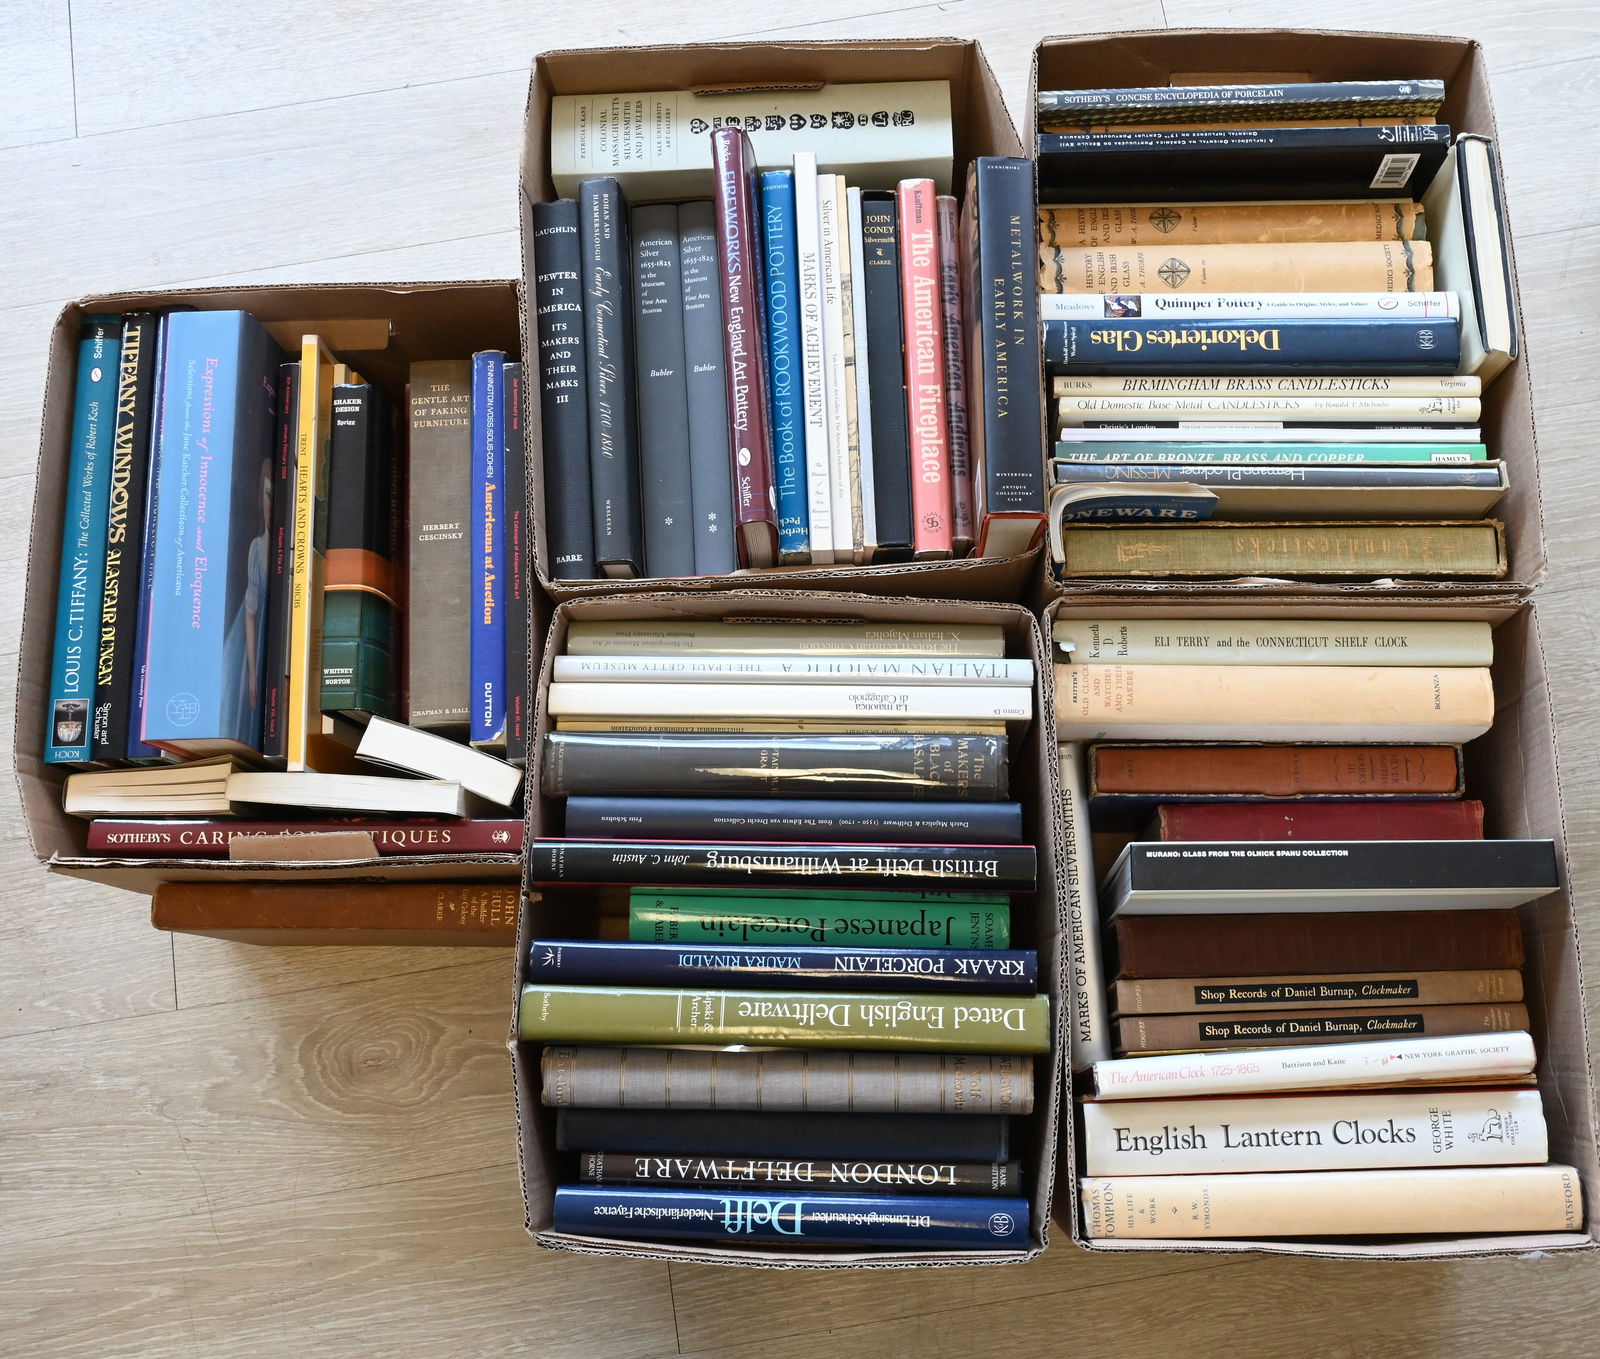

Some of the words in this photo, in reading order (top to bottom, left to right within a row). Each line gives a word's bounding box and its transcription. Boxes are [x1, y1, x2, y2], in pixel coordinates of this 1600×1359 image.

[1064, 95, 1110, 104] SOTHEBY'S
[1155, 92, 1219, 101] ENCYCLOPEDIA
[1235, 90, 1284, 98] PORCELAIN
[536, 226, 576, 237] LAUGHLIN
[726, 171, 741, 273] FIREWORKS
[683, 234, 714, 243] American
[683, 245, 701, 253] Silver
[769, 205, 784, 276] POTTERY
[912, 229, 933, 267] The
[641, 260, 671, 268] 1655-1825
[824, 239, 833, 281] American
[1010, 216, 1023, 319] METALWORK
[538, 272, 577, 282] PEWTER
[803, 253, 817, 299] MARKS
[729, 276, 743, 302] New
[538, 304, 581, 314] AMERICA
[994, 279, 1005, 330] EARLY
[1155, 298, 1213, 310] Quimper
[1218, 297, 1263, 310] Pottery
[728, 307, 747, 356] England
[913, 276, 938, 374] American
[94, 328, 104, 358] Schiffer
[542, 338, 579, 347] MAKERS
[770, 281, 791, 396] ROOKWOOD
[1091, 330, 1143, 351] Glas
[1147, 330, 1280, 350] Dekoriertes
[118, 326, 141, 416] TIFFANY
[546, 366, 576, 375] THEIR
[650, 369, 673, 377] Buhler
[693, 364, 716, 372] Buhler
[734, 359, 747, 384] Art
[806, 325, 823, 428] ACHIEVEMENT
[996, 340, 1008, 418] AMERICA
[200, 358, 218, 433] Expressions
[431, 384, 450, 392] THE
[546, 380, 578, 389] MARKS
[1122, 379, 1220, 390] BIRMINGHAM
[1226, 378, 1272, 390] BRASS
[1278, 379, 1390, 390] CANDLESTICKS
[412, 396, 447, 405] GENTLE
[451, 395, 469, 403] ART
[414, 408, 427, 416] OF
[735, 386, 748, 431] Pottery
[1077, 400, 1096, 410] Old
[1101, 400, 1145, 409] Domestic
[1208, 400, 1300, 409] CANDLESTICKS
[88, 401, 98, 428] Koch
[414, 418, 469, 427] FURNITURE
[86, 429, 95, 450] Robert
[779, 420, 794, 464] Book
[916, 384, 944, 484] Fireplace
[82, 460, 95, 485] Works
[108, 422, 134, 544] WINDOWS
[299, 466, 308, 503] HEARTS
[1105, 466, 1170, 478] MESSING
[198, 457, 212, 523] Innocence
[80, 490, 91, 529] Collected
[485, 482, 496, 557] Americana
[295, 530, 304, 574] CROWNS
[556, 554, 582, 563] BARRE
[102, 550, 120, 623] ALASTAIR
[190, 556, 207, 628] Eloquence
[484, 572, 495, 624] Auction
[1089, 624, 1099, 658] Kenneth
[1118, 626, 1127, 656] Roberts
[1155, 637, 1170, 646] ELI
[1177, 637, 1209, 647] TERRY
[1217, 638, 1232, 647] and
[1237, 638, 1249, 647] the
[1256, 636, 1328, 648] CONNECTICUT
[1335, 637, 1368, 647] SHELF
[1375, 637, 1408, 647] CLOCK
[98, 626, 116, 686] DUNCAN
[581, 662, 636, 670] MUSEUM
[64, 647, 81, 693] LOUIS
[912, 664, 1008, 678] ITALIAN
[484, 683, 492, 727] DUTTON
[849, 693, 896, 703] Cafaggiolo
[94, 707, 103, 739] Schuster
[107, 833, 170, 844] SOTHEBY'S
[1062, 789, 1078, 886] SILVERSMITHS
[613, 853, 647, 864] Austin
[664, 854, 689, 864] John
[707, 850, 842, 874] Williamsburg
[876, 859, 924, 876] Delft
[932, 860, 998, 877] British
[701, 914, 827, 942] Porcelain
[835, 910, 956, 945] Japanese
[1070, 891, 1085, 963] AMERICAN
[679, 955, 740, 967] RINALDI
[744, 956, 800, 968] MAURA
[834, 957, 944, 973] PORCELAIN
[956, 959, 1025, 975] KRAAK
[1201, 990, 1225, 1001] Shop
[1229, 989, 1267, 999] Records
[1272, 988, 1281, 997] of
[1285, 987, 1316, 997] Daniel
[1320, 987, 1357, 998] Burnap,
[1362, 985, 1411, 996] Clockmaker
[738, 1002, 850, 1026] Delftware
[860, 1003, 944, 1029] English
[954, 1007, 1026, 1030] Dated
[1081, 1002, 1090, 1042] MARKS
[1206, 1026, 1229, 1037] Shop
[1234, 1024, 1271, 1034] Records
[1276, 1023, 1286, 1032] of
[1290, 1022, 1320, 1032] Daniel
[1325, 1021, 1362, 1033] Burnap,
[1367, 1020, 1417, 1030] Clockmaker
[1130, 1068, 1178, 1081] American
[1180, 1066, 1205, 1079] Clock
[1212, 1063, 1260, 1076] 1725-1865
[1113, 1126, 1207, 1155] English
[1220, 1122, 1321, 1148] Lantern
[1333, 1120, 1416, 1145] Clocks
[1429, 1107, 1441, 1152] GEORGE
[1442, 1111, 1453, 1149] WHITE
[635, 1158, 814, 1182] DELFTWARE
[830, 1163, 956, 1185] LONDON
[594, 1206, 632, 1218] Fayence
[634, 1206, 713, 1220] Niederländische
[1104, 1183, 1115, 1238] TOMPION
[1562, 1174, 1574, 1228] BATSFORD
[720, 1200, 805, 1234] Delft
